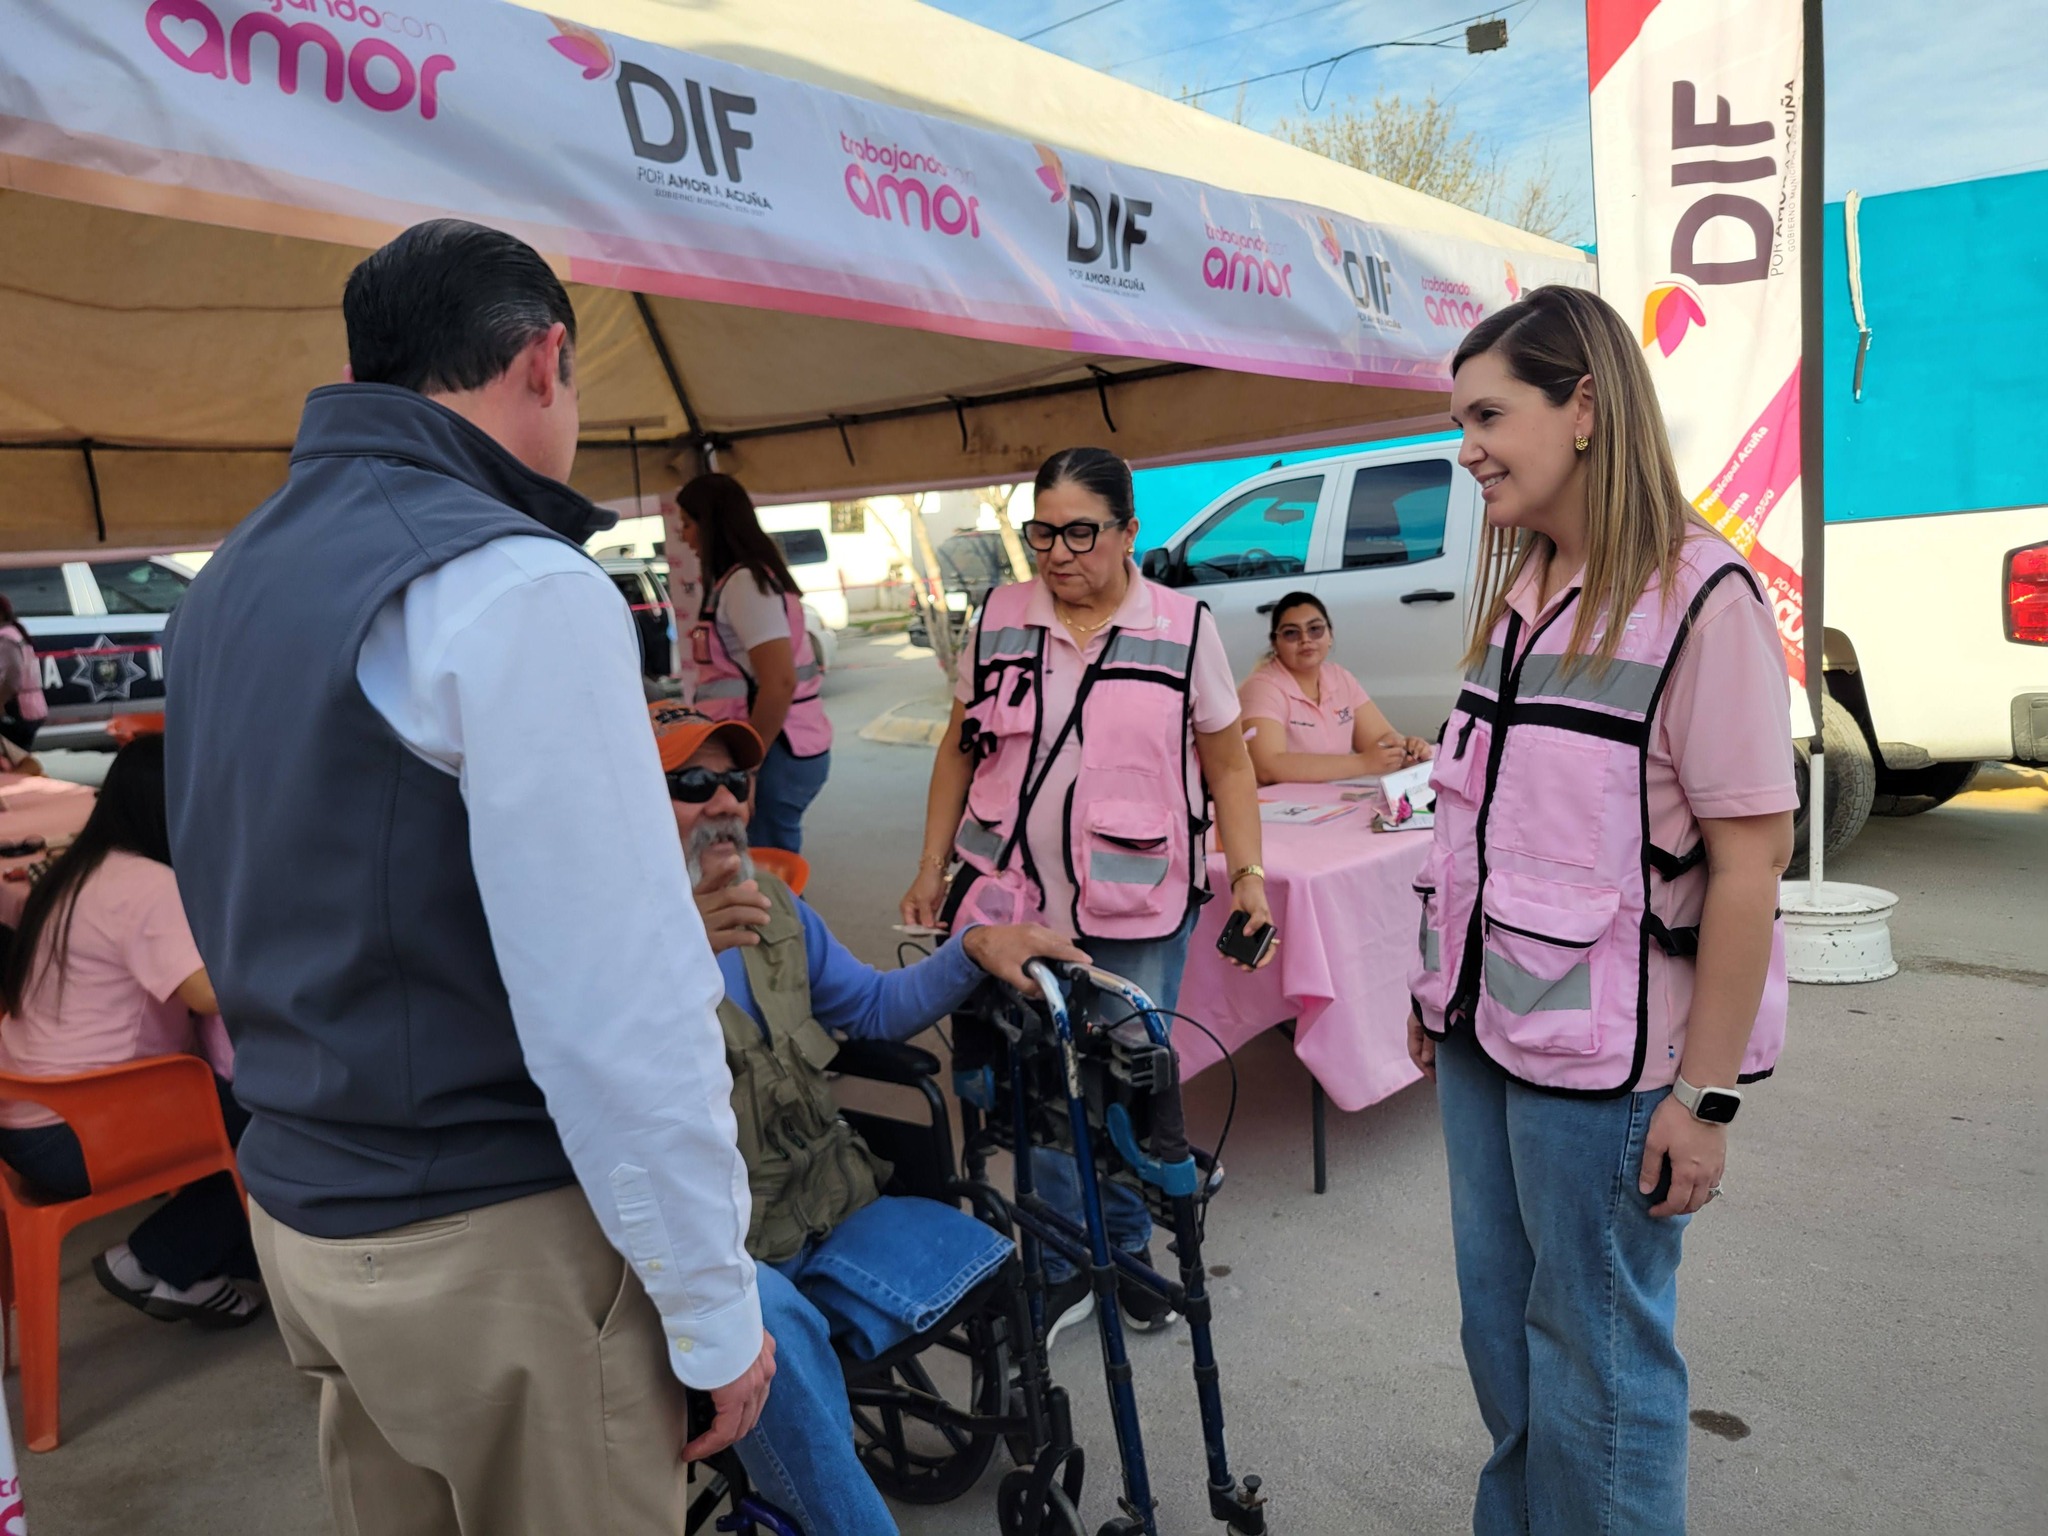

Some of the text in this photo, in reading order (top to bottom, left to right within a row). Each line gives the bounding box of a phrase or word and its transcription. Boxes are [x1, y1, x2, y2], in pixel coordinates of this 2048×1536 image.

[145, 0, 456, 120] amor
[615, 60, 757, 183] DIF
[637, 167, 665, 185] POR
[668, 174, 711, 196] AMOR
[726, 187, 773, 210] ACUÑA
[845, 163, 980, 239] amor
[1670, 80, 1777, 286] DIF
[1067, 184, 1153, 272] DIF
[1787, 202, 1796, 252] GOBIERNO
[1085, 272, 1110, 286] AMOR
[1203, 246, 1292, 298] amor
[1770, 243, 1784, 276] POR
[1424, 295, 1484, 330] amor
[1698, 426, 1769, 512] Municipal Acuña
